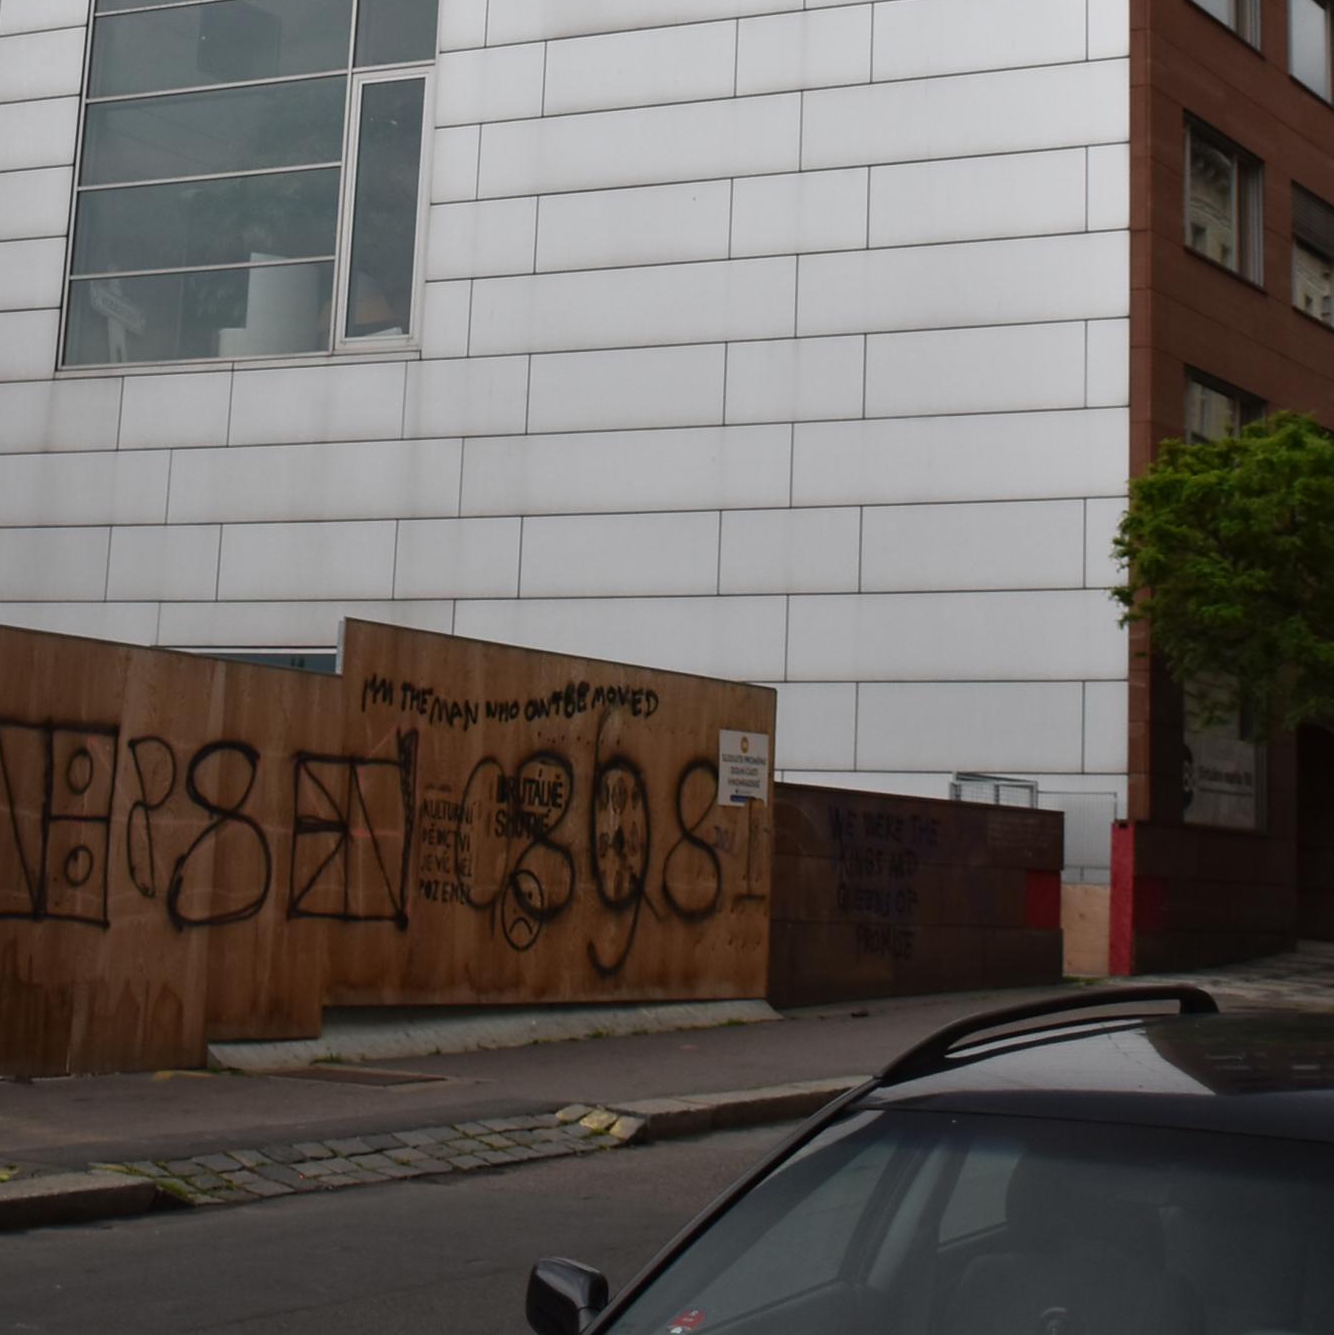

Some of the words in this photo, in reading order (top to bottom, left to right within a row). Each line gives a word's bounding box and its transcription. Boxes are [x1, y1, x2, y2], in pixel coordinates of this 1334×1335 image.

[401, 680, 434, 715] THE
[429, 696, 478, 732] MAN
[486, 699, 519, 724] WHO
[591, 684, 659, 717] MOVED
[912, 815, 942, 848] THE
